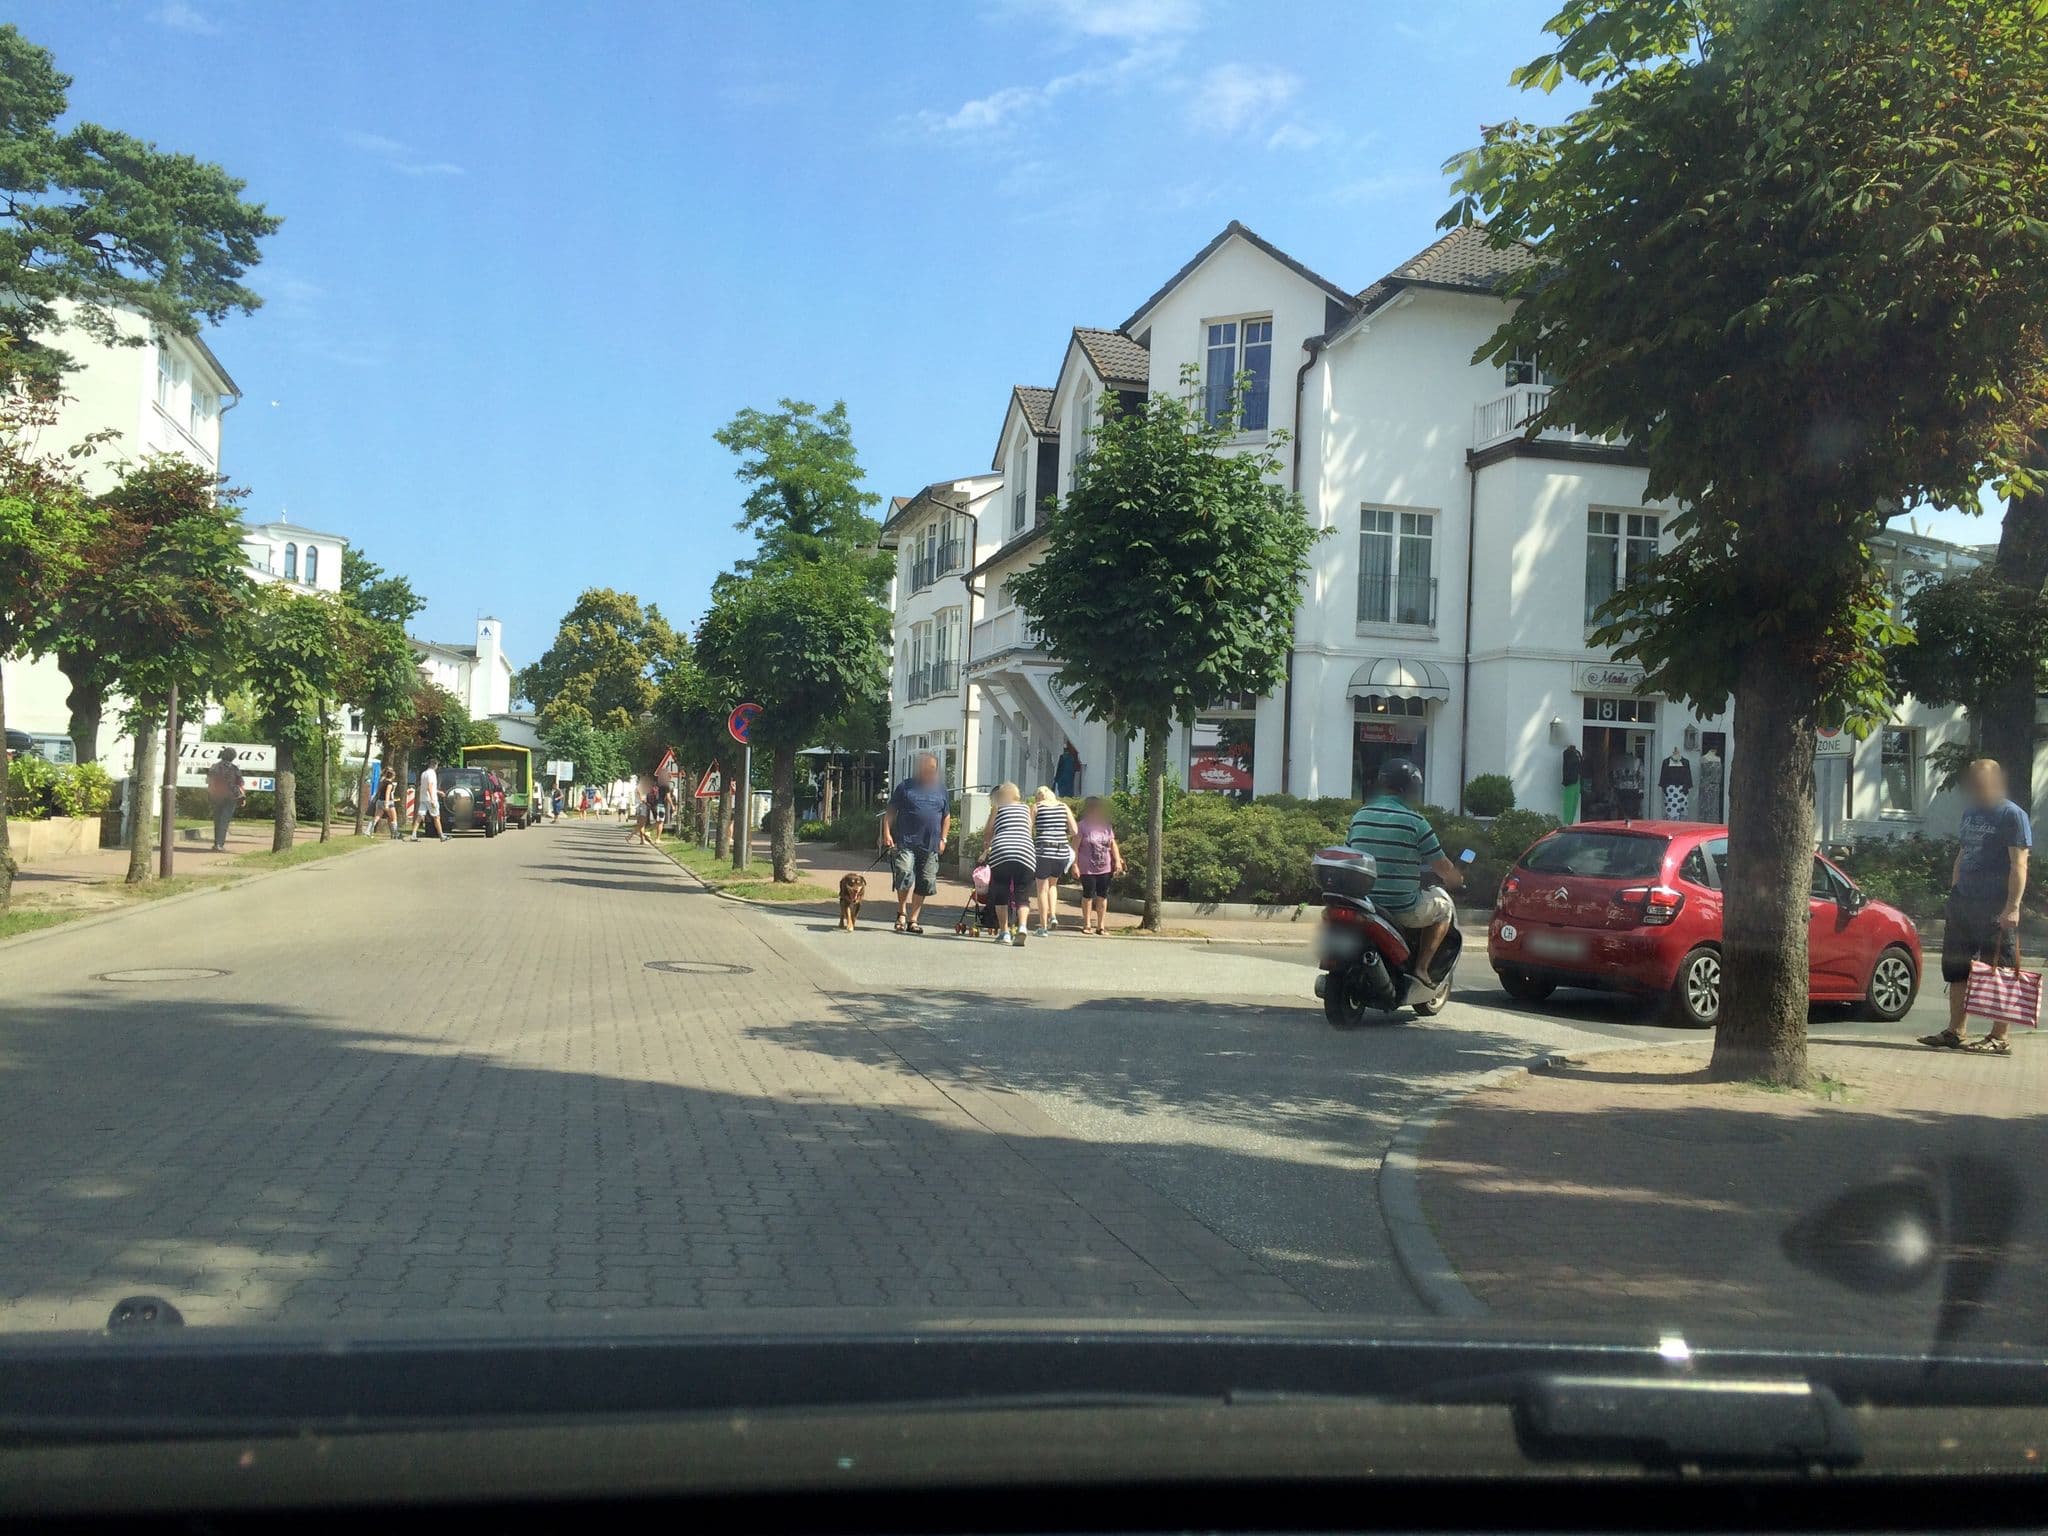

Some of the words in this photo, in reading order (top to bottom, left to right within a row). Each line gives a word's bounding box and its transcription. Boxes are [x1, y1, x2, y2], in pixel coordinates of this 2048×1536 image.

[1602, 701, 1614, 719] 8
[1817, 740, 1840, 751] ZONE
[1503, 927, 1513, 939] CH
